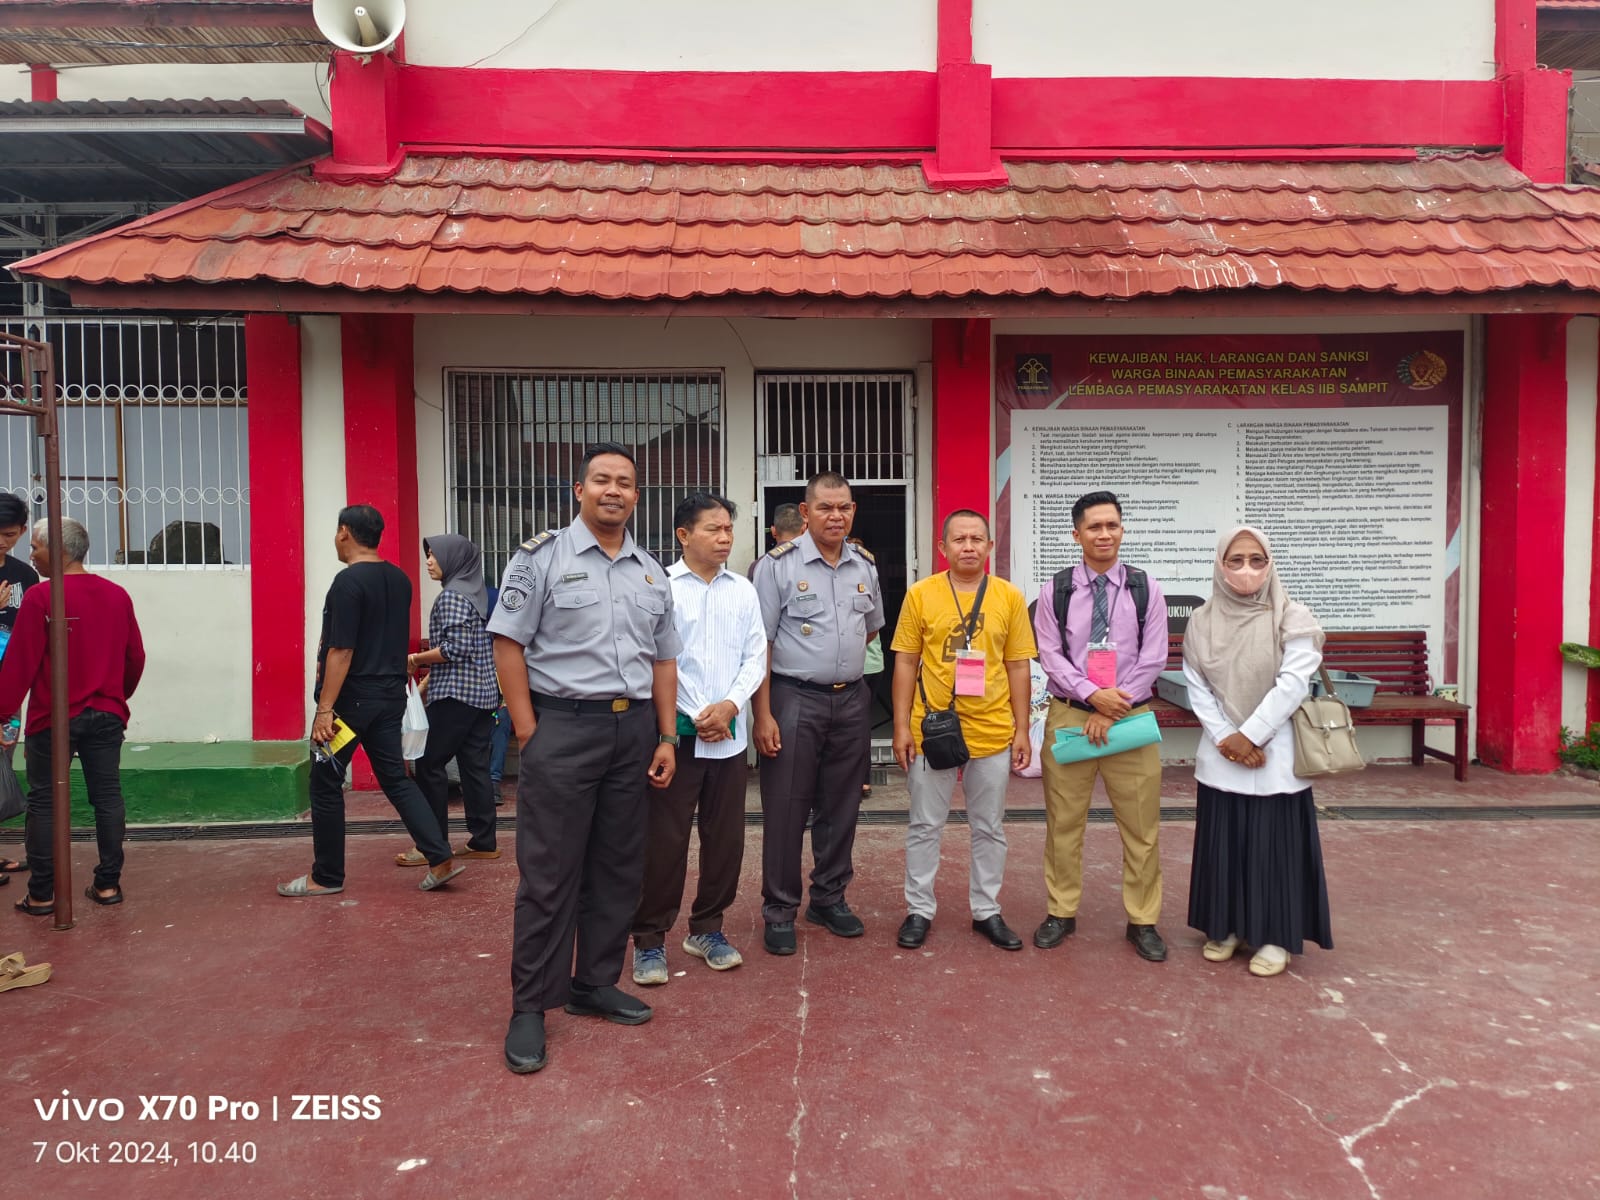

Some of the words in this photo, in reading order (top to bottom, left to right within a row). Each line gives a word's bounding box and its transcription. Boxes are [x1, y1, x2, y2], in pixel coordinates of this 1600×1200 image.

[1089, 352, 1171, 365] KEWAJIBAN,
[1175, 352, 1206, 364] HAK,
[1210, 352, 1284, 363] LARANGAN
[1288, 352, 1316, 362] DAN
[1320, 351, 1368, 362] SANKSI
[1111, 368, 1161, 380] WARGA
[1165, 368, 1215, 379] BINAAN
[1218, 368, 1346, 379] PEMASYARAKATAN
[1068, 384, 1134, 396] LEMBAGA
[1138, 384, 1266, 395] PEMASYARAKATAN
[1271, 384, 1314, 394] KELAS
[1318, 383, 1335, 394] IIB
[1339, 382, 1388, 394] SAMPIT
[1168, 606, 1192, 618] UKUM
